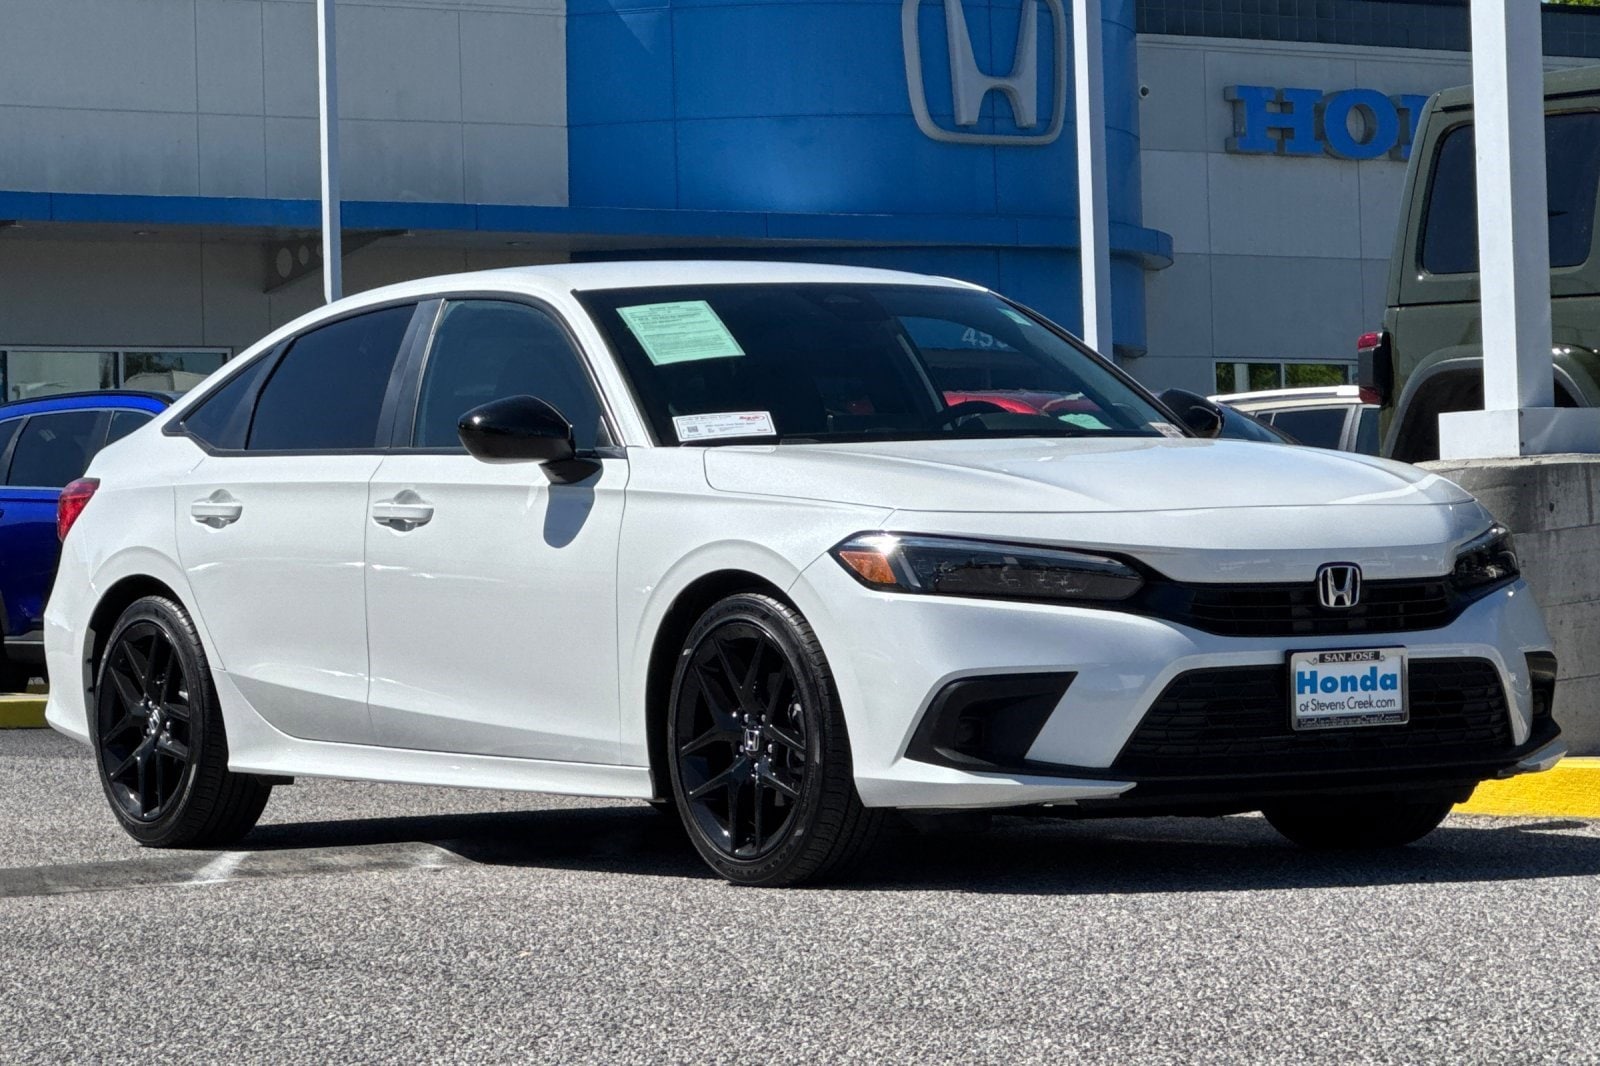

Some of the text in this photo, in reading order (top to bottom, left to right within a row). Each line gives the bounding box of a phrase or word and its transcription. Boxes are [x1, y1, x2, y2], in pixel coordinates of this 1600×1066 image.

[1324, 651, 1375, 662] SAN JOSE
[1297, 666, 1398, 695] Honda
[1300, 694, 1396, 712] of Stevens Creek.com
